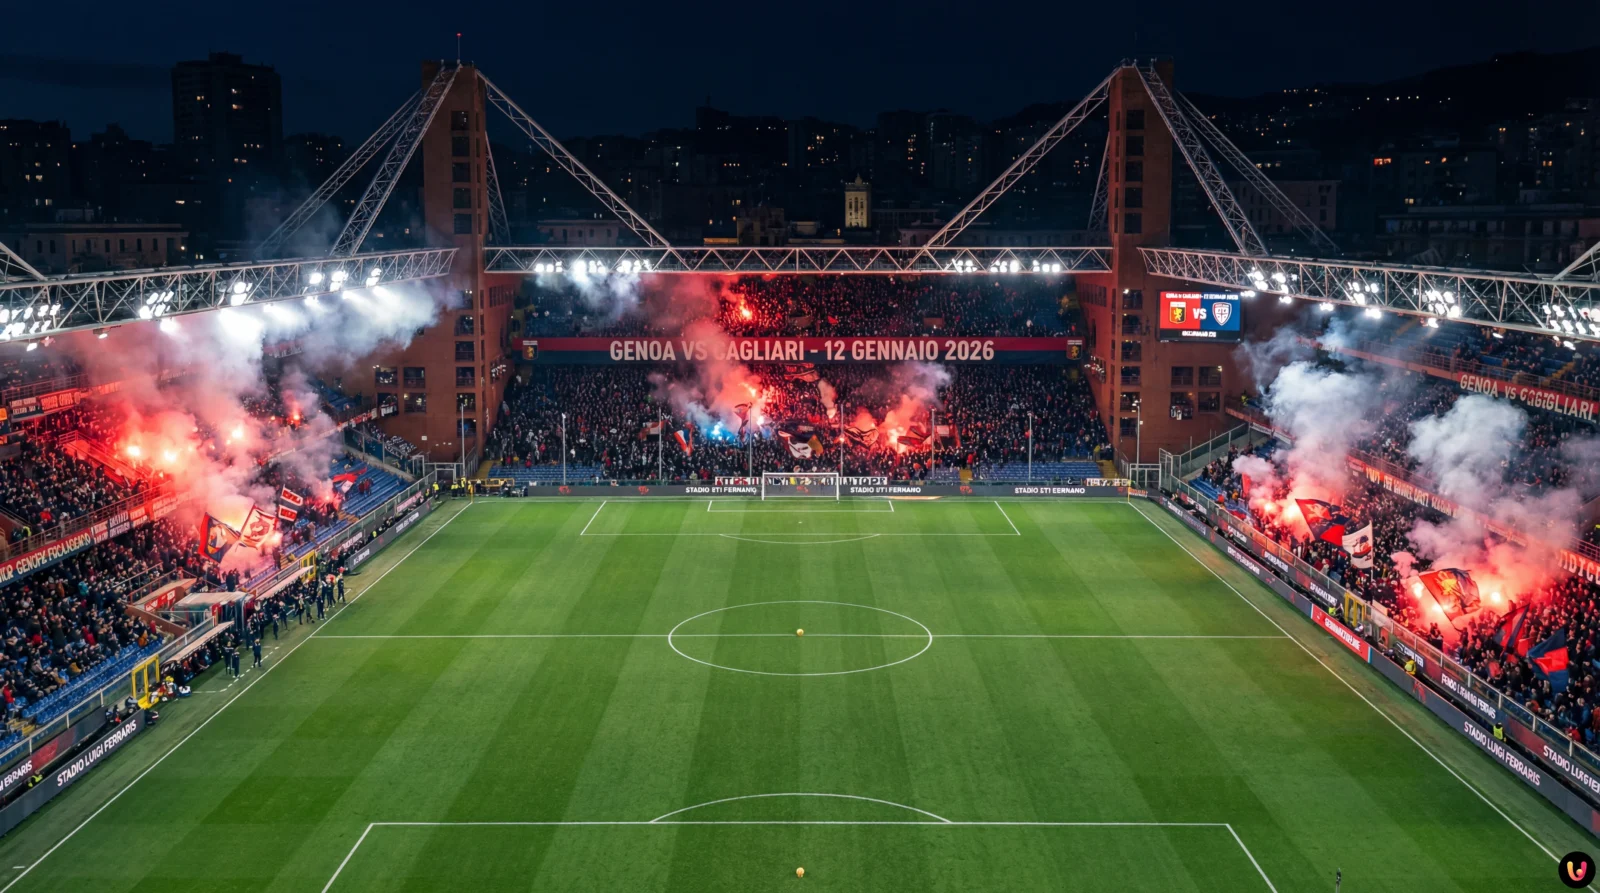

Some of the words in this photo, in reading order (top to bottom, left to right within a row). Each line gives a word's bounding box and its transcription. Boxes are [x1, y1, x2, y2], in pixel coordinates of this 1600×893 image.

[1193, 308, 1206, 319] VS
[610, 340, 676, 361] GENOA
[681, 340, 708, 361] VS
[824, 340, 845, 361] 12
[852, 340, 938, 361] GENNAIO
[945, 340, 994, 361] 2026
[1460, 374, 1498, 397] GENOA
[1505, 386, 1516, 399] VS
[57, 759, 84, 786] STADIO
[84, 747, 103, 766] LUIGI
[104, 720, 137, 752] FERRARIS
[1464, 721, 1487, 746] STADIO
[1487, 738, 1505, 760] LUIGI
[1505, 752, 1540, 786] FERRARIS
[1543, 745, 1570, 771] STADIO
